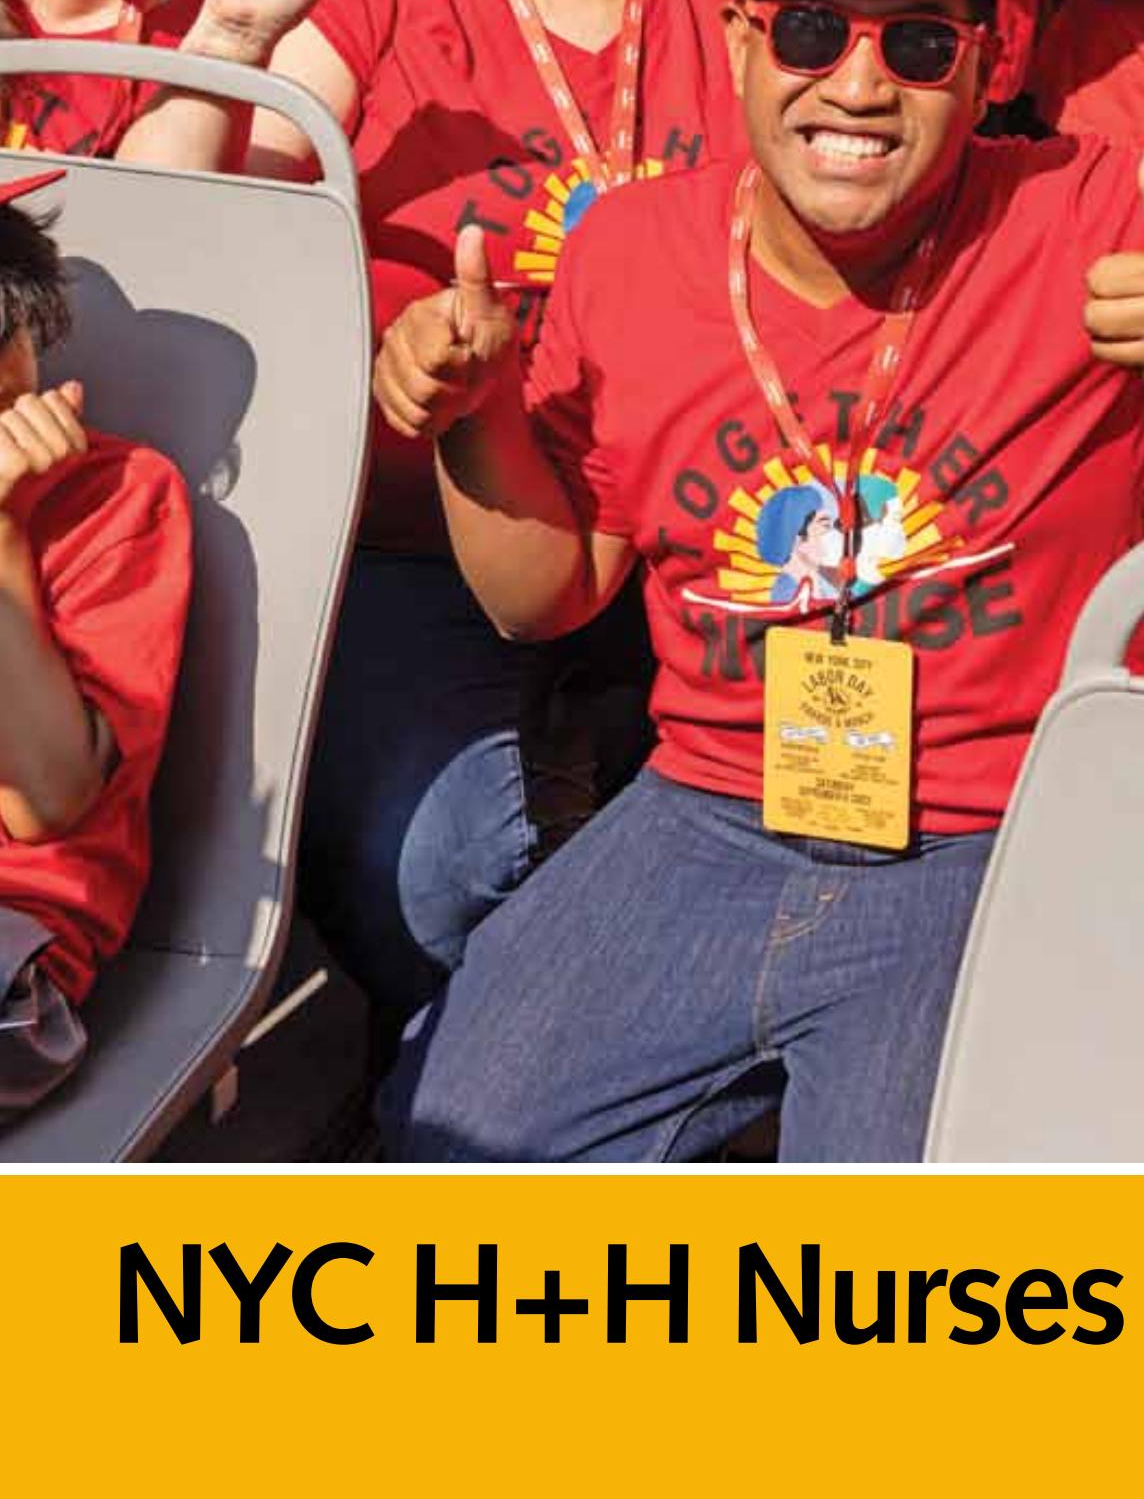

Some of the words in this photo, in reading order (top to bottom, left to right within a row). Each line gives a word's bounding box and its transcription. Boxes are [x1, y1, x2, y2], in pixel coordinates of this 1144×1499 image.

[828, 557, 1024, 650] ISE
[800, 668, 845, 693] LABOR
[847, 673, 875, 699] DAY
